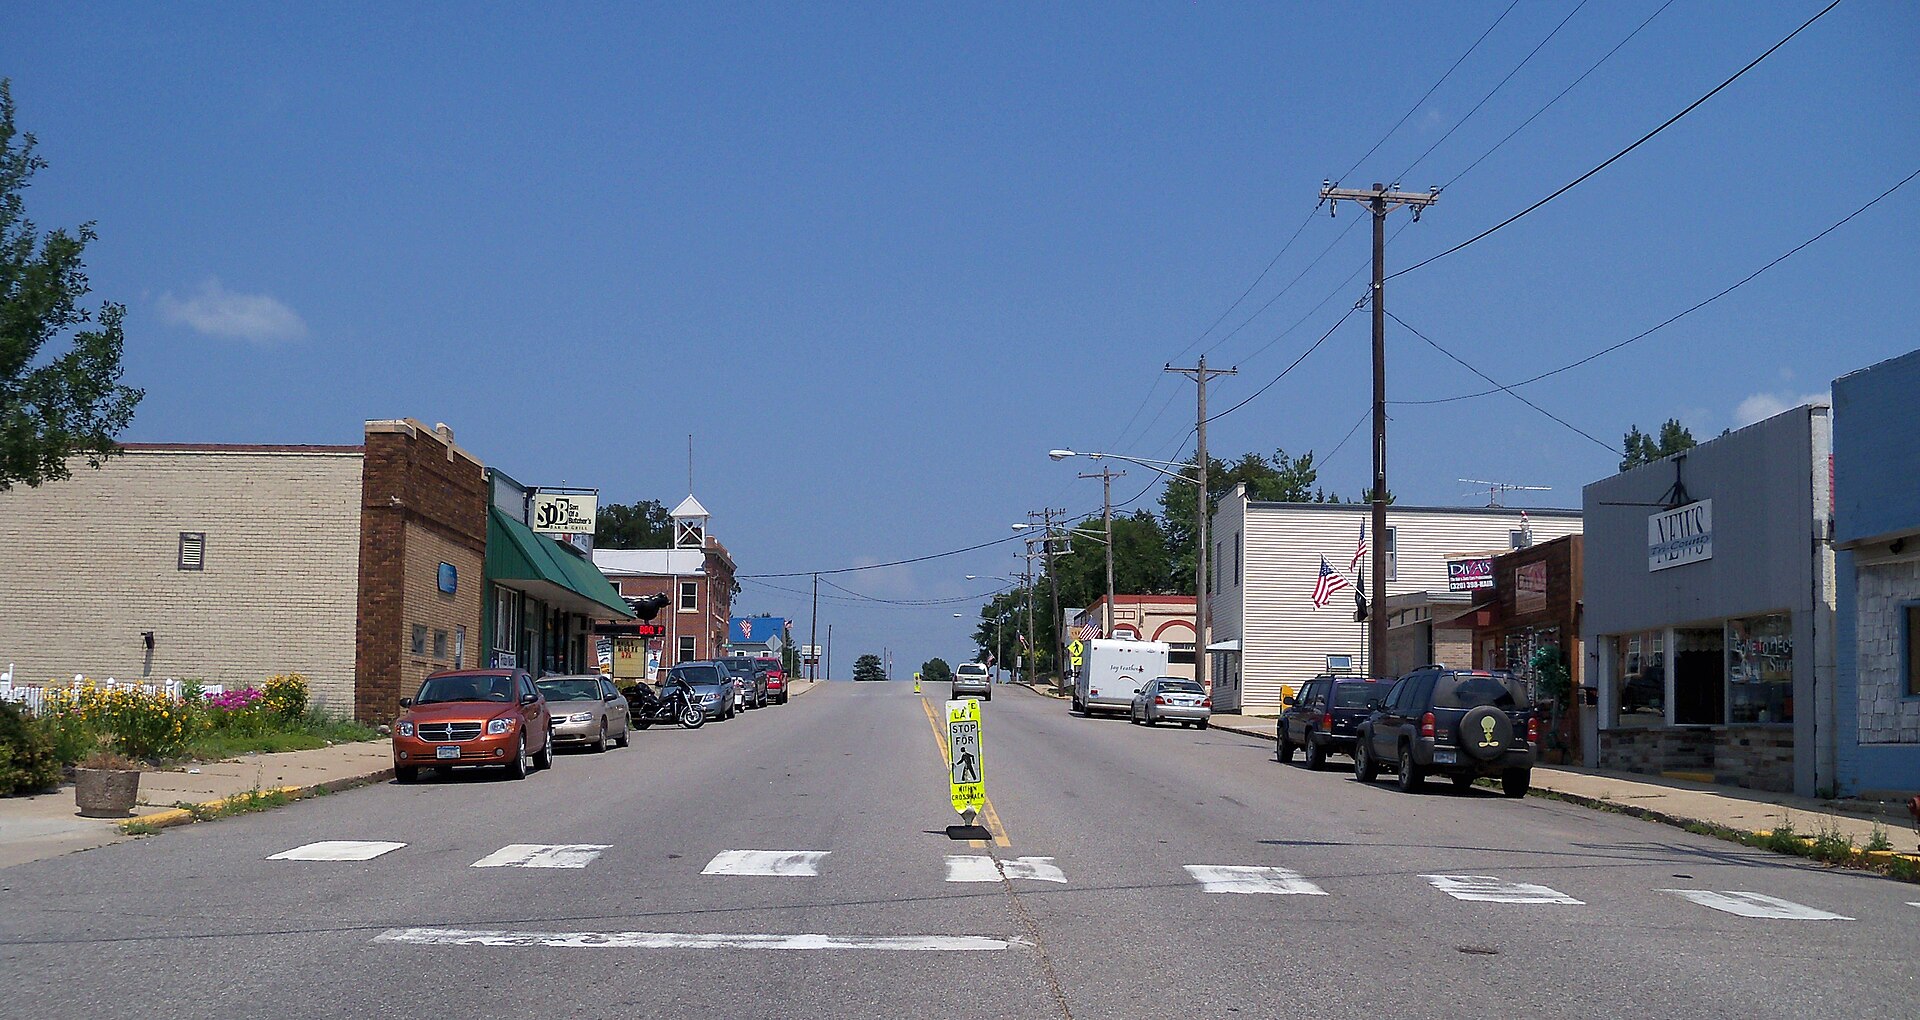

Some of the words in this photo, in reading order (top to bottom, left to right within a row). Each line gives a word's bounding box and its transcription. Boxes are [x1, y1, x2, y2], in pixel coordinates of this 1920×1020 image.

[537, 498, 570, 529] SOB
[568, 517, 592, 525] Butcher's
[1657, 505, 1704, 564] NEWS
[1449, 561, 1491, 575] DIVA'S
[952, 724, 976, 734] STOP
[955, 736, 974, 745] FOR
